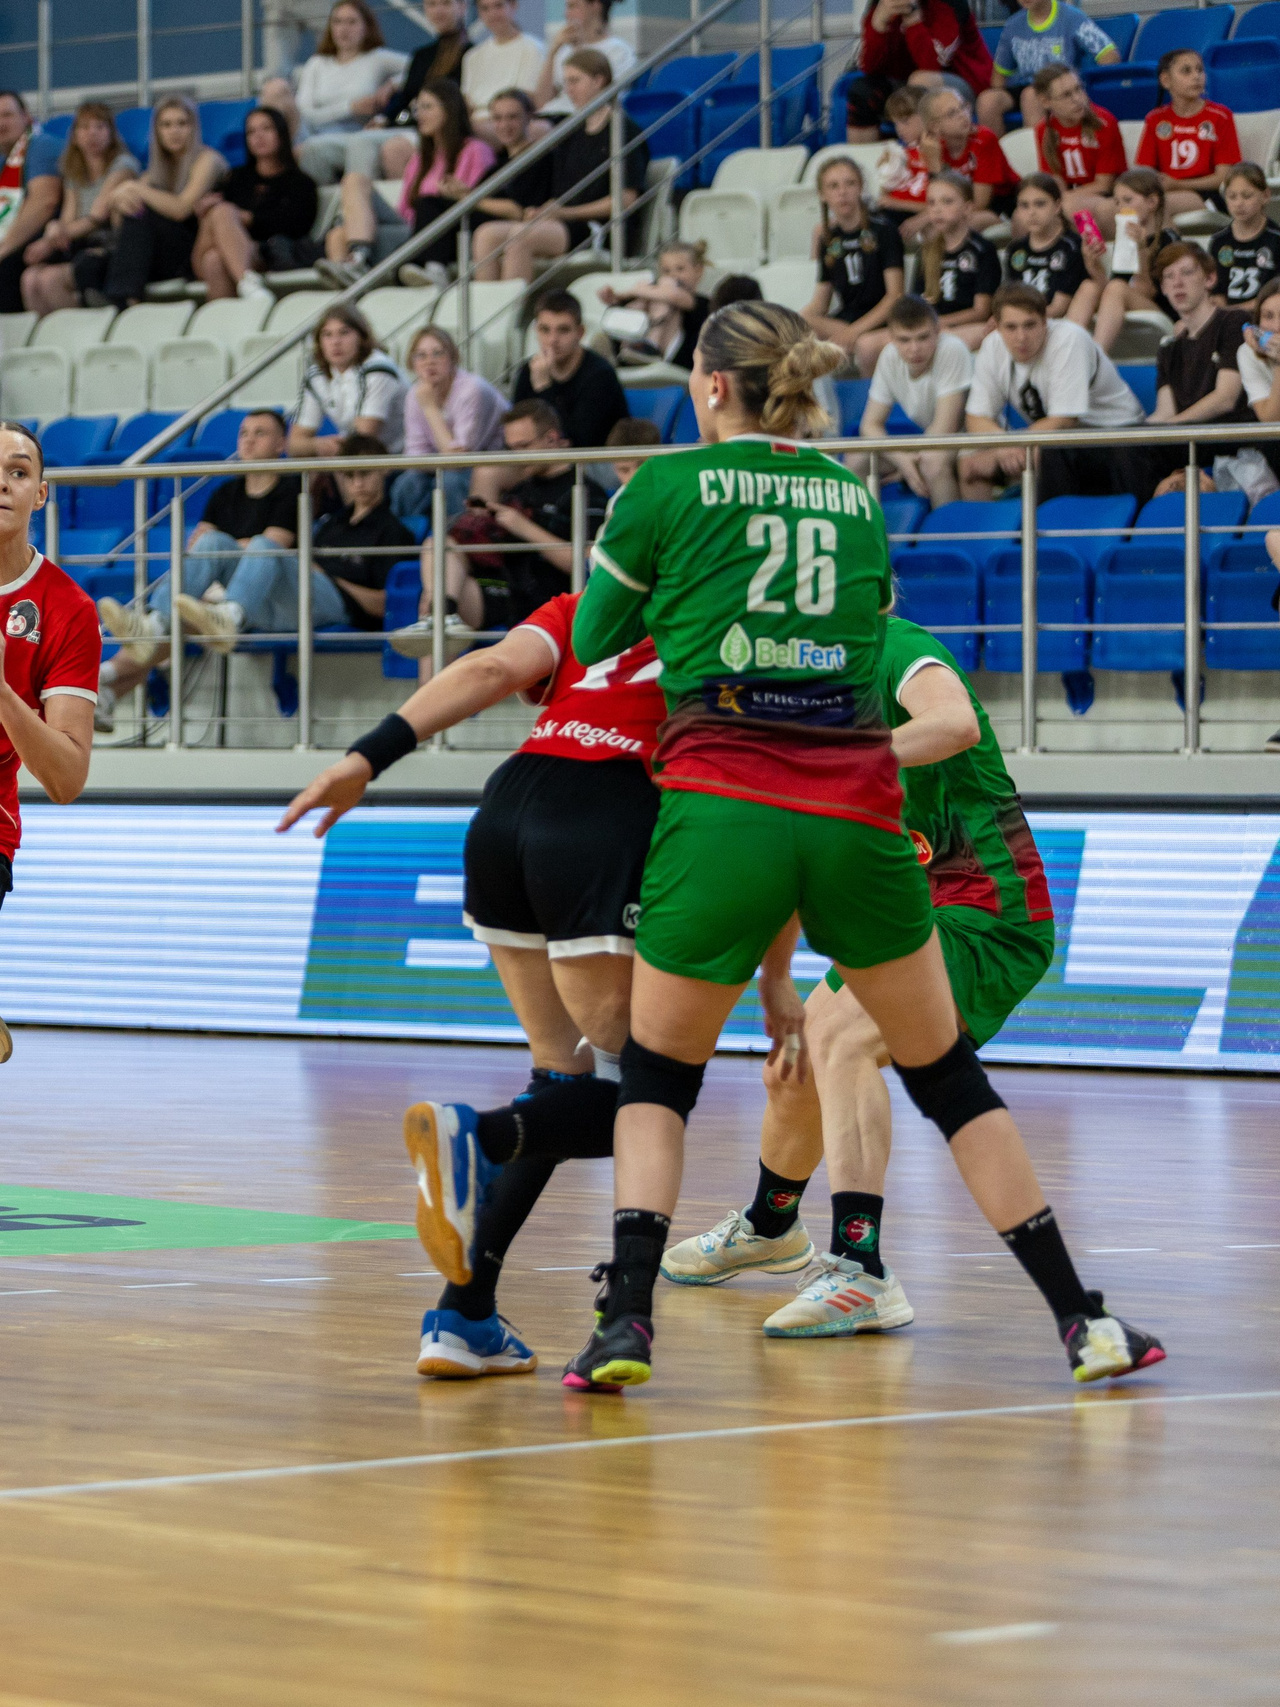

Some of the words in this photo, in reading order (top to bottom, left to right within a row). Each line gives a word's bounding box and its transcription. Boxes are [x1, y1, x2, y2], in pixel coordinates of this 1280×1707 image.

[1062, 148, 1088, 178] 11
[1170, 139, 1199, 170] 19
[1227, 266, 1261, 299] 23
[698, 468, 872, 521] СУПРУНОВИЧ
[746, 513, 837, 616] 26
[755, 637, 847, 671] BelFert
[557, 720, 644, 753] Region
